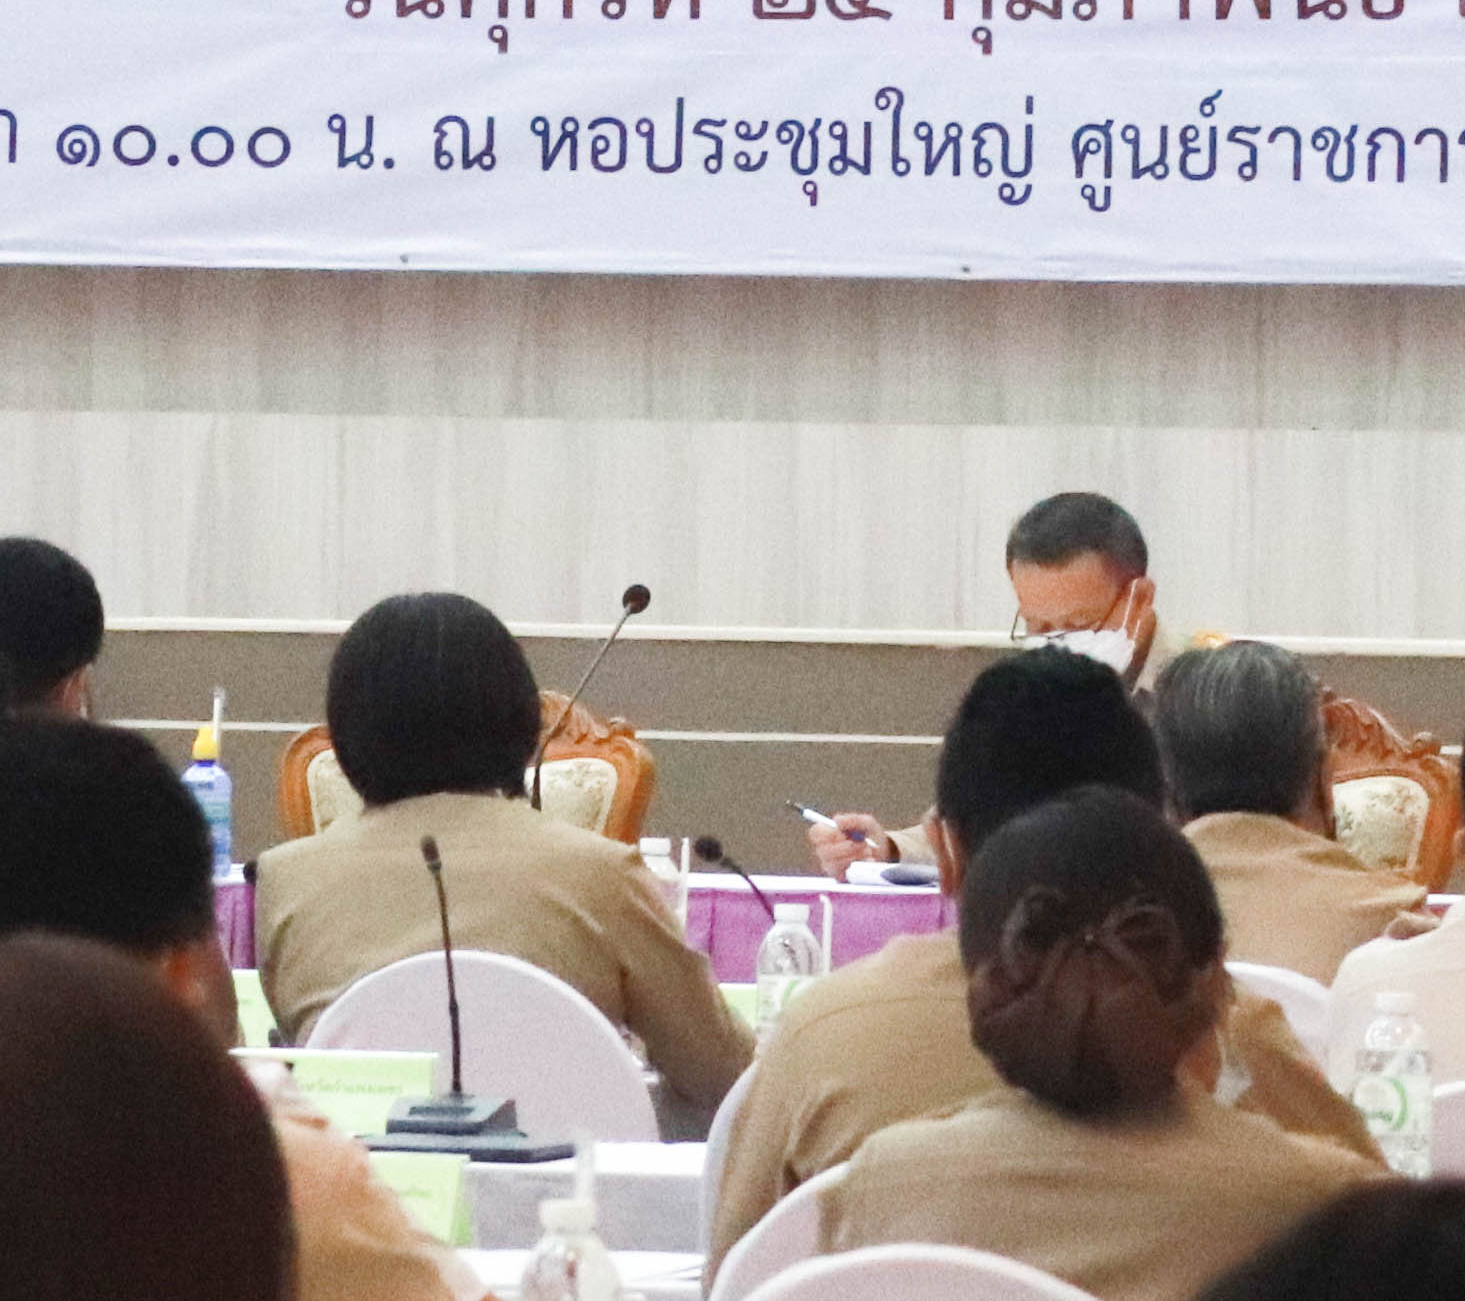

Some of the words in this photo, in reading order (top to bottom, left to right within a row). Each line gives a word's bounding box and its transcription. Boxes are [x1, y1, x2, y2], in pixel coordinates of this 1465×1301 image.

[54, 122, 293, 170] ๑๐.๐๐
[325, 111, 397, 172] น.
[432, 113, 499, 174] ณ
[533, 84, 1036, 209] หอประชุมใหญ่
